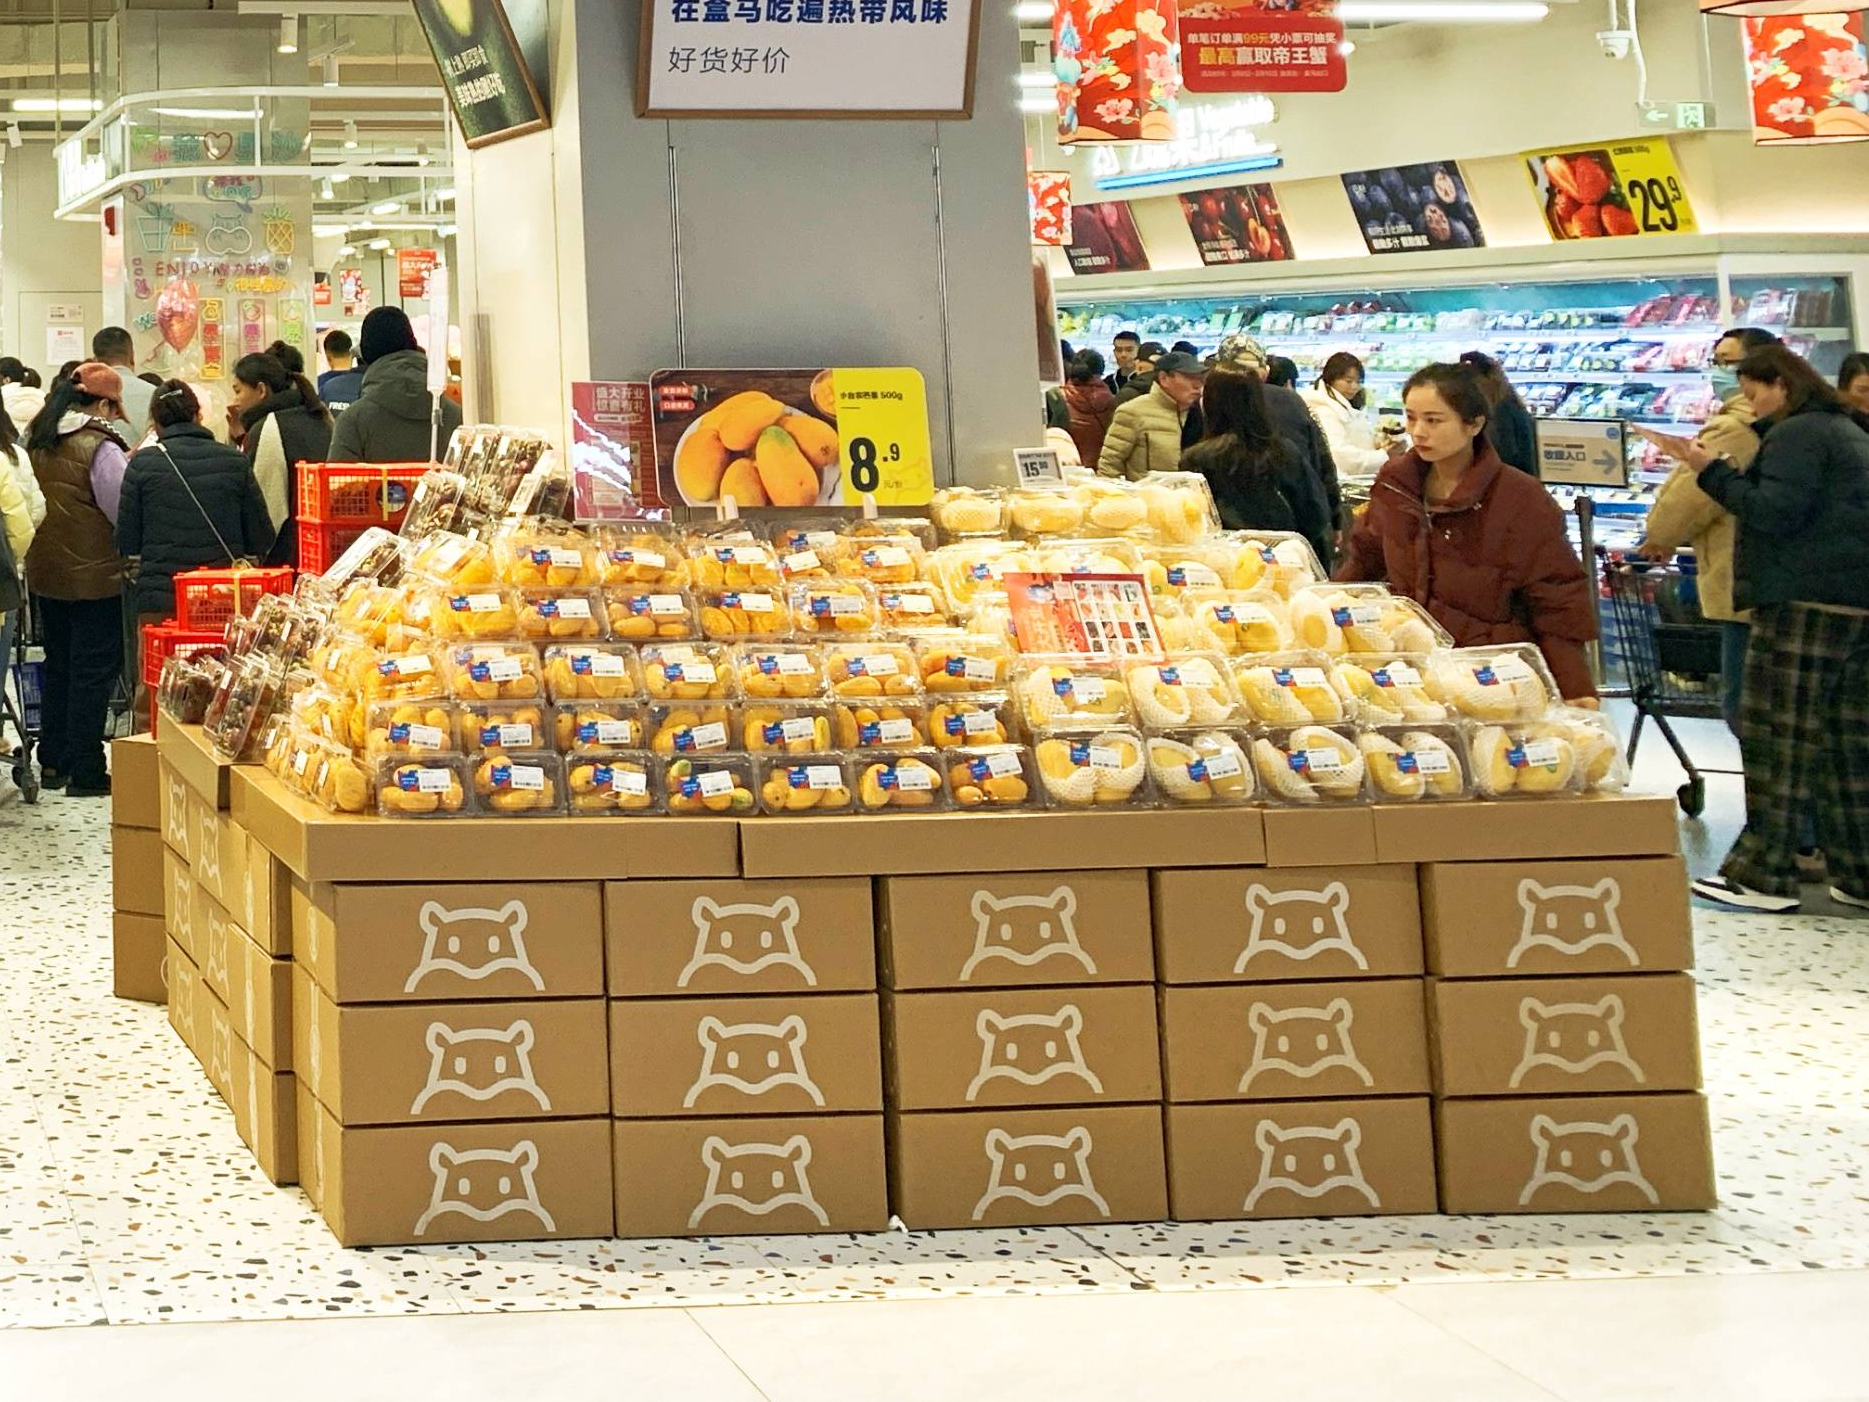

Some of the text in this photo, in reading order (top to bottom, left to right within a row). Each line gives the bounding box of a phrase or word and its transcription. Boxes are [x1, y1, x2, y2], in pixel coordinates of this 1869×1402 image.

[668, 46, 790, 74] 好货好价
[1199, 46, 1328, 65] 最高赢取帝王蟹
[849, 436, 900, 493] 8.9
[1543, 450, 1586, 462] 收银入口
